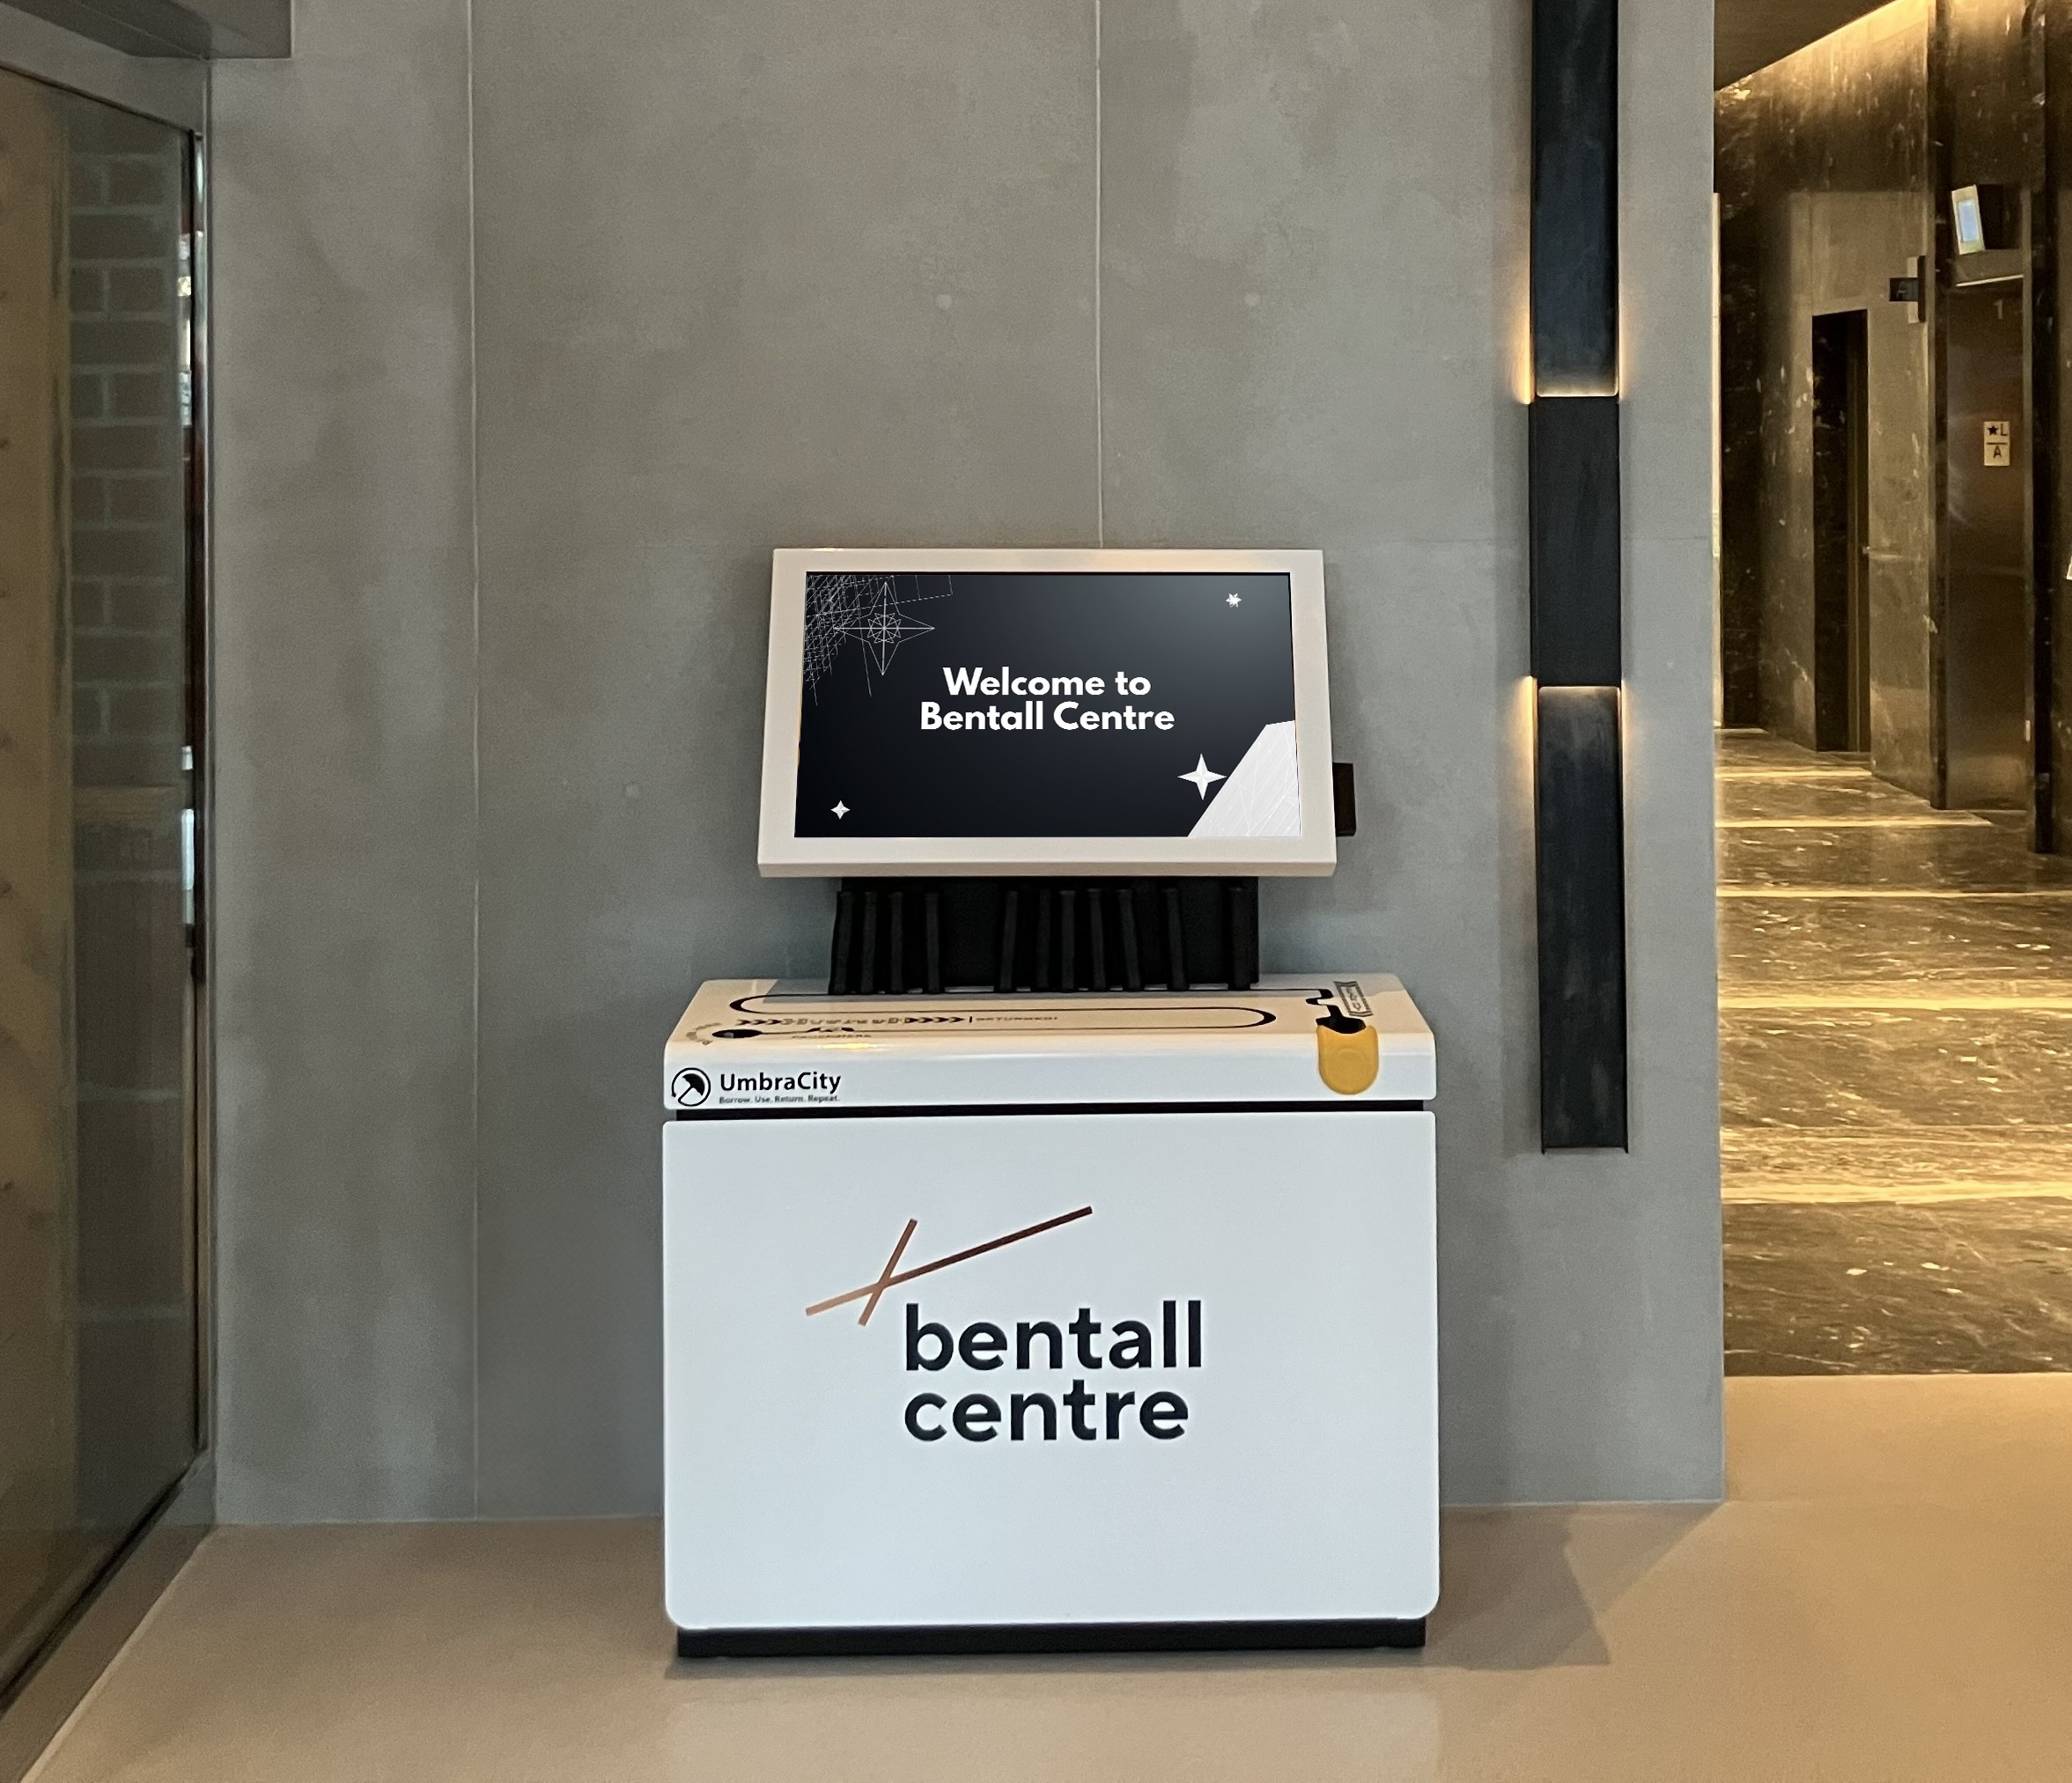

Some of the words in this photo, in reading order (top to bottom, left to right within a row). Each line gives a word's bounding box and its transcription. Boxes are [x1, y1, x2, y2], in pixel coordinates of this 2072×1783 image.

[1994, 298, 2003, 320] 1
[1993, 446, 2002, 459] A
[943, 667, 1104, 696] Welcome
[1115, 671, 1152, 696] to
[921, 701, 1043, 731] Bentall
[1053, 701, 1175, 731] Centre
[720, 1072, 842, 1094] UmbraCity
[906, 1300, 1202, 1371] bentall
[905, 1380, 1189, 1441] centre
